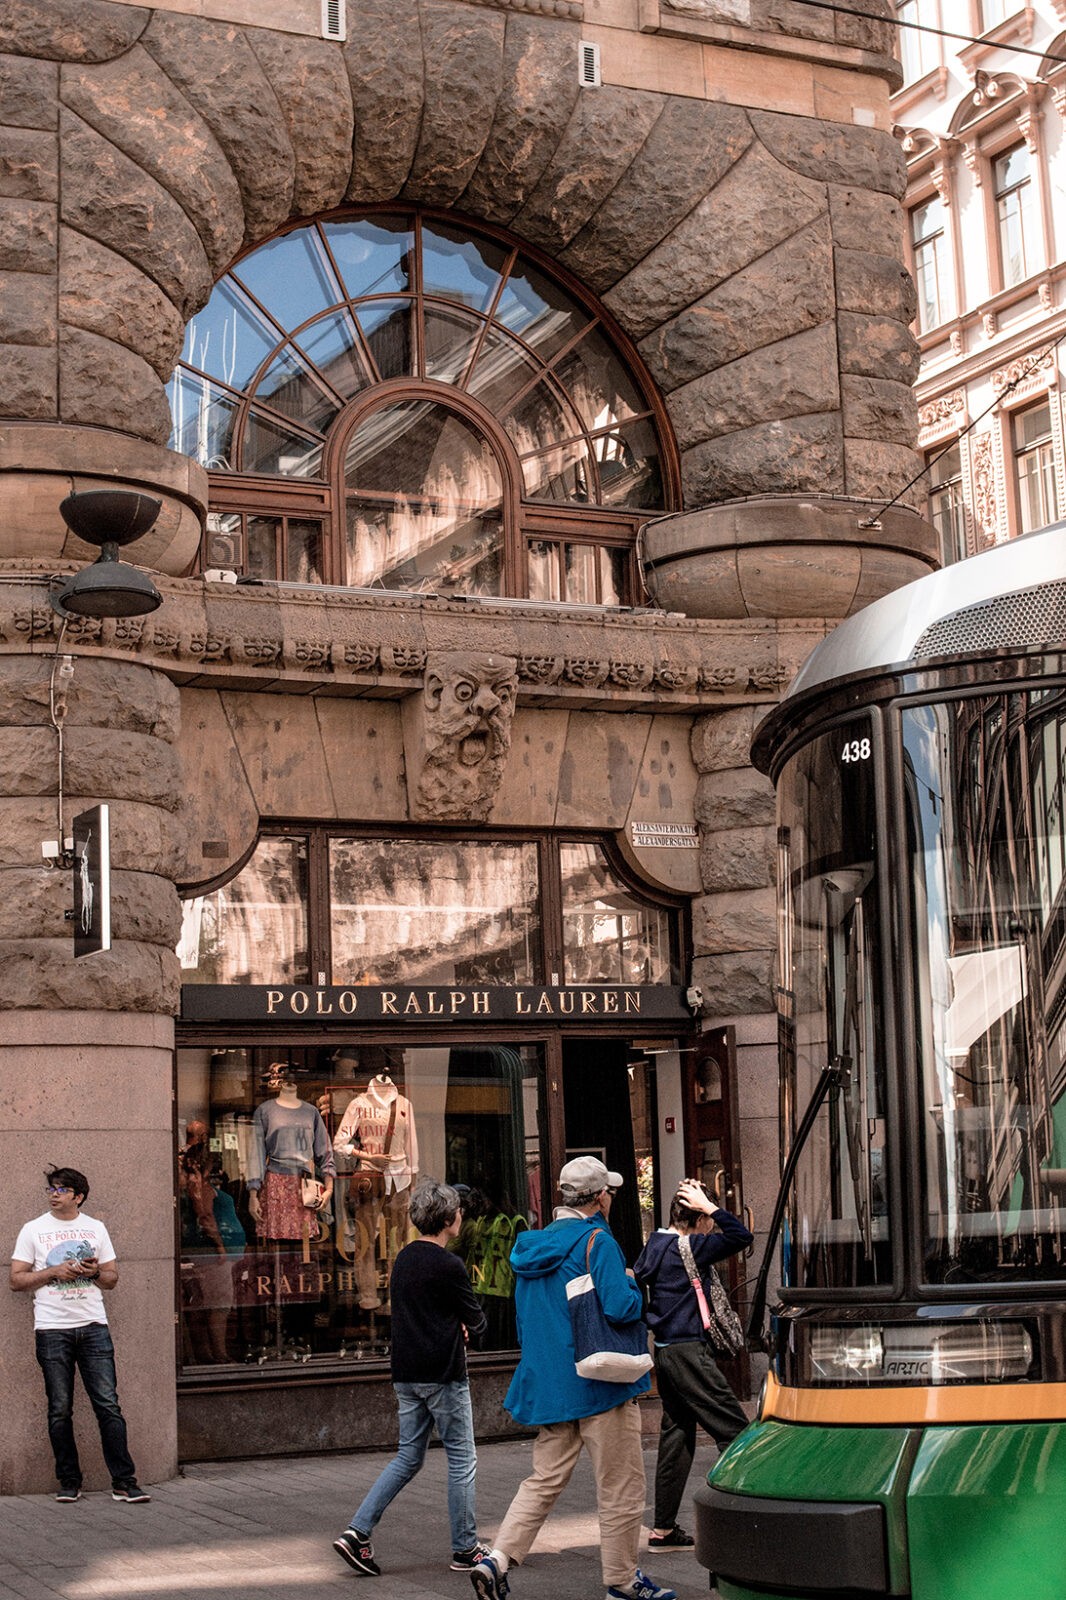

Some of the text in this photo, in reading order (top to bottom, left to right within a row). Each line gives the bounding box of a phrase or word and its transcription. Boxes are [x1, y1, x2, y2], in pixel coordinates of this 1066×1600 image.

[841, 738, 871, 763] 438
[638, 836, 698, 847] ALEXANDERSGATAN
[266, 990, 641, 1015] POLO RALPH LAUREN
[355, 1107, 381, 1119] THE
[55, 1232, 77, 1241] POLO
[257, 1271, 355, 1296] RALPH
[886, 1361, 929, 1375] ARTIC
